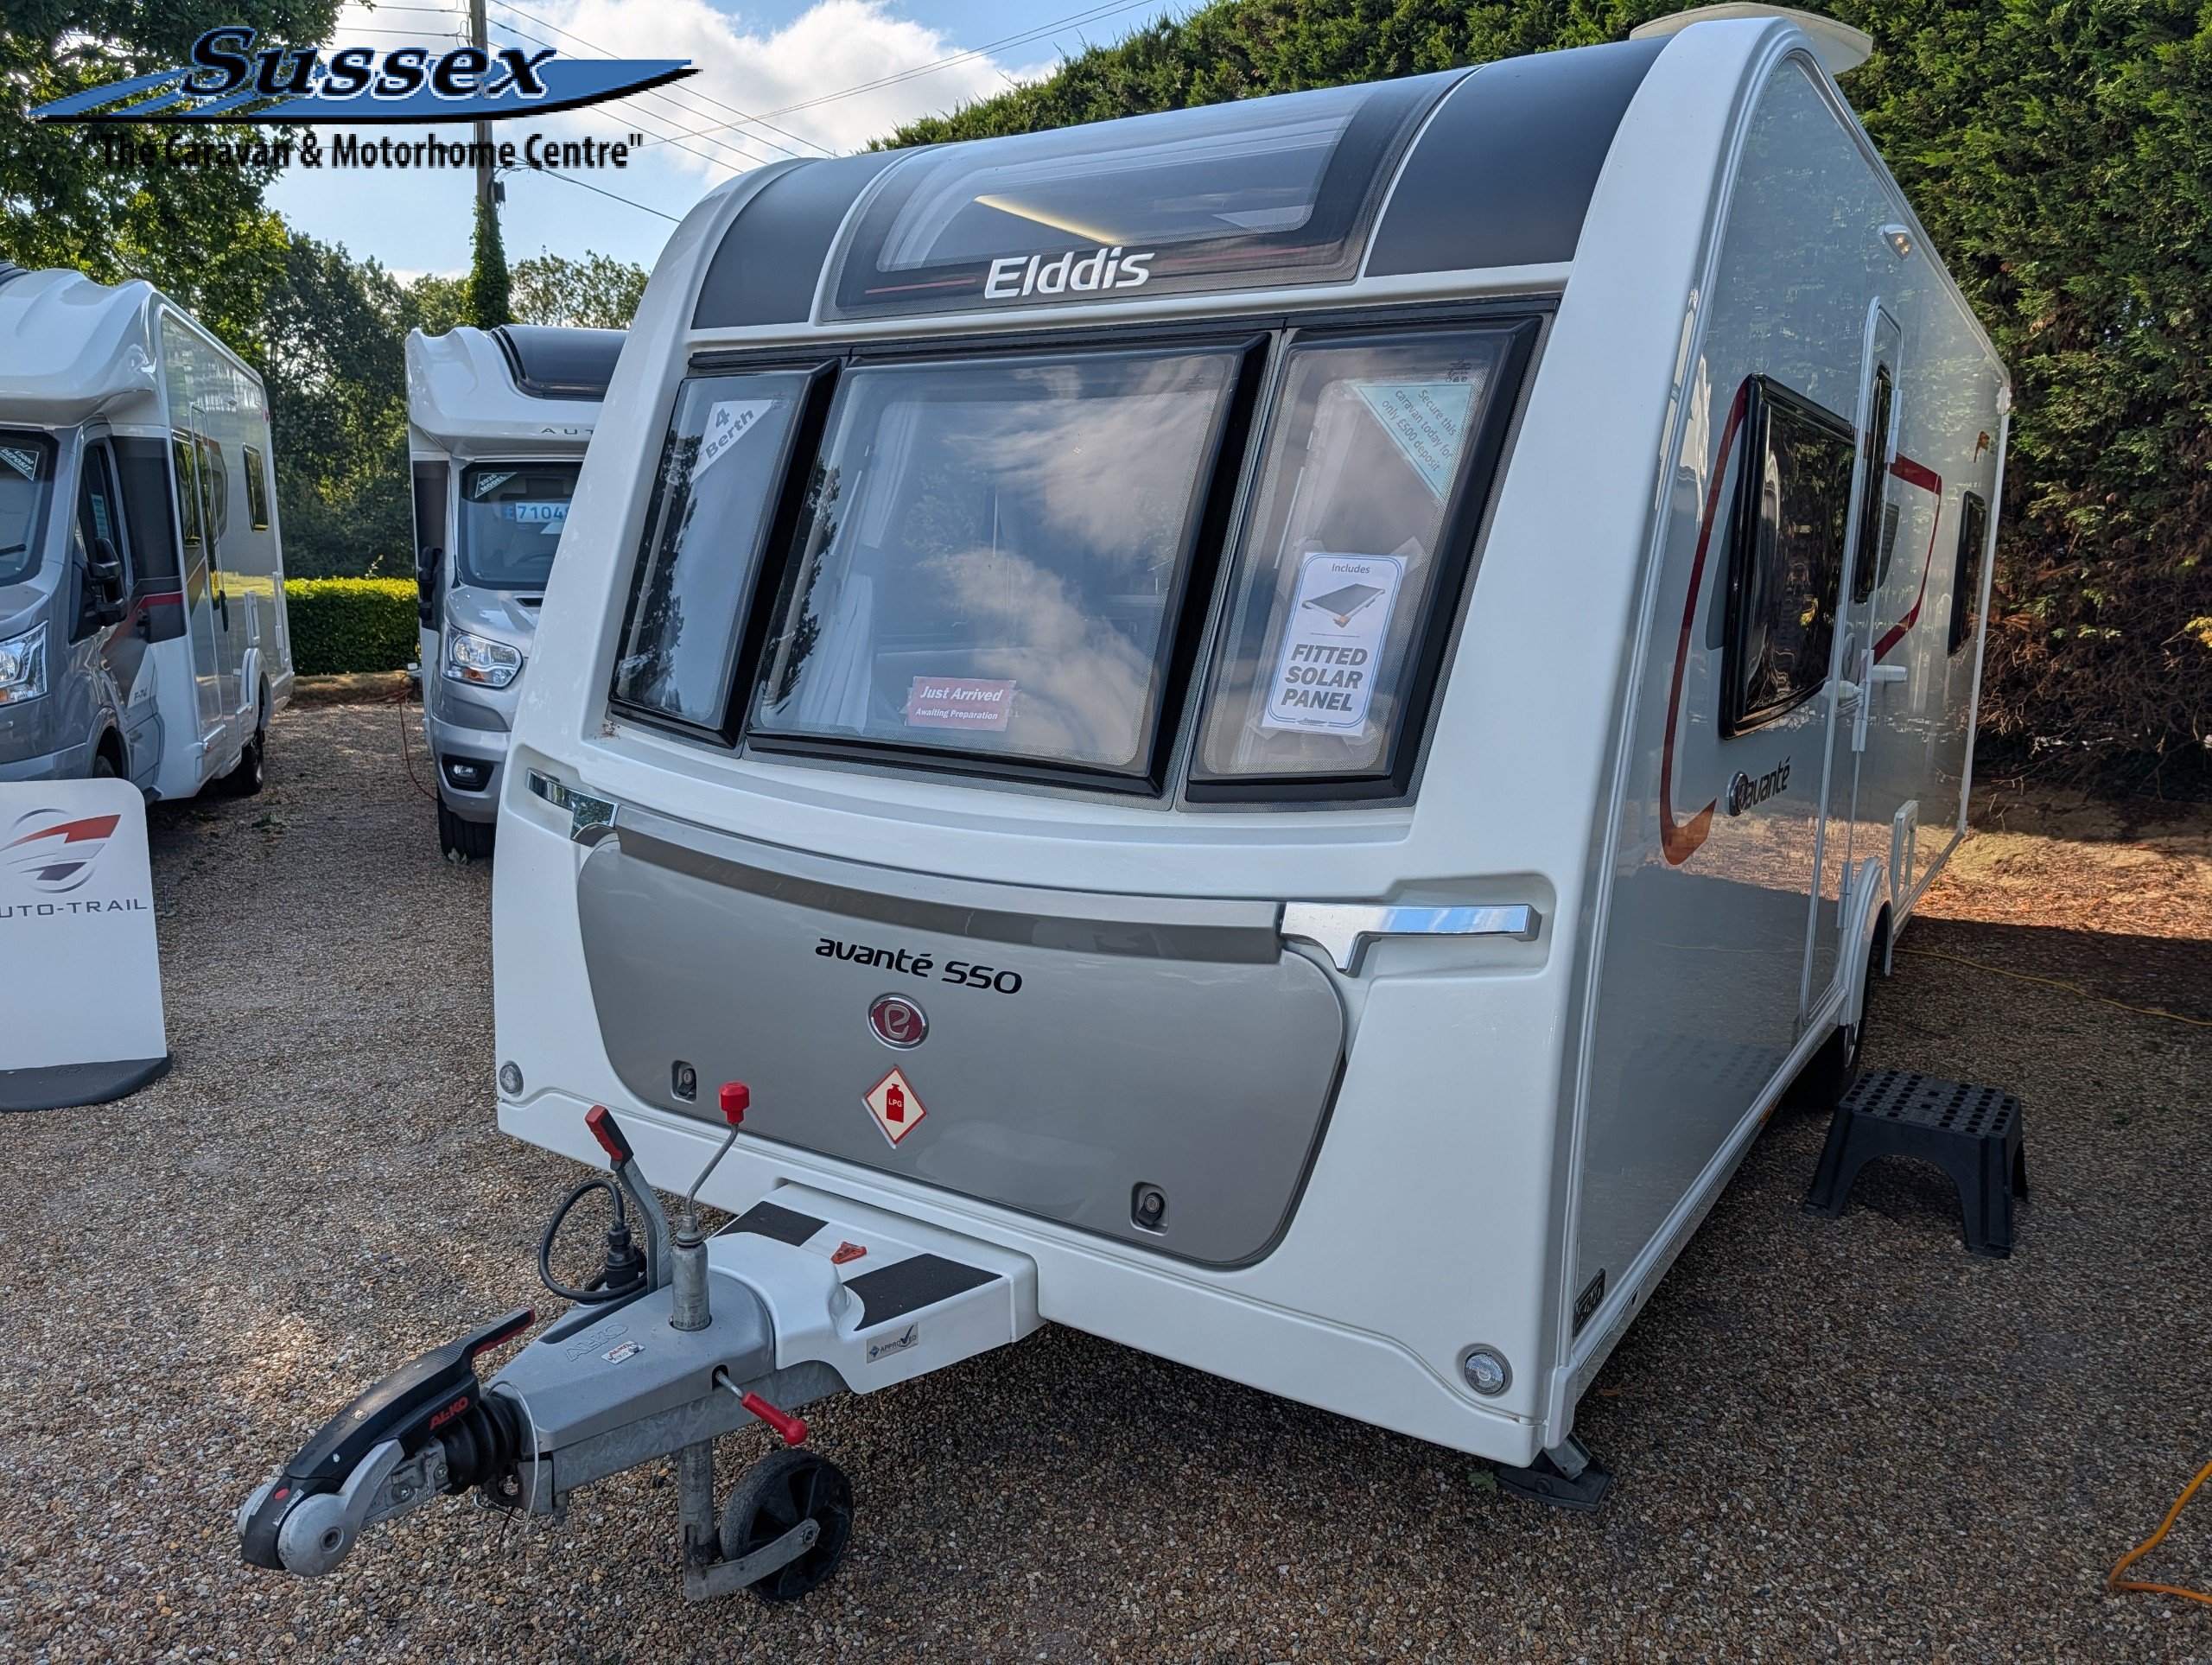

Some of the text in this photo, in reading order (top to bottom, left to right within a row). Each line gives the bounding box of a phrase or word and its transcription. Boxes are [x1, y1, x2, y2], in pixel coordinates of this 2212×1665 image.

[984, 247, 1155, 299] Elddis
[715, 408, 731, 428] 4
[1419, 390, 1457, 435] Secure this
[705, 410, 754, 459] Berth
[1382, 400, 1440, 471] only £500 deposit
[1395, 391, 1452, 459] caravan today for
[1, 448, 33, 471] DEPOSIT
[480, 475, 506, 492] MODEL
[1332, 563, 1370, 574] Includes
[1291, 644, 1368, 666] FITTED
[1284, 666, 1363, 689] SOLAR
[920, 686, 1003, 702] Just Arrived
[1281, 689, 1353, 712] PANEL
[916, 708, 998, 721] Awaiting Preparation
[815, 937, 933, 977] avanté
[888, 1098, 902, 1108] LPG
[429, 1396, 468, 1431] AL-KO
